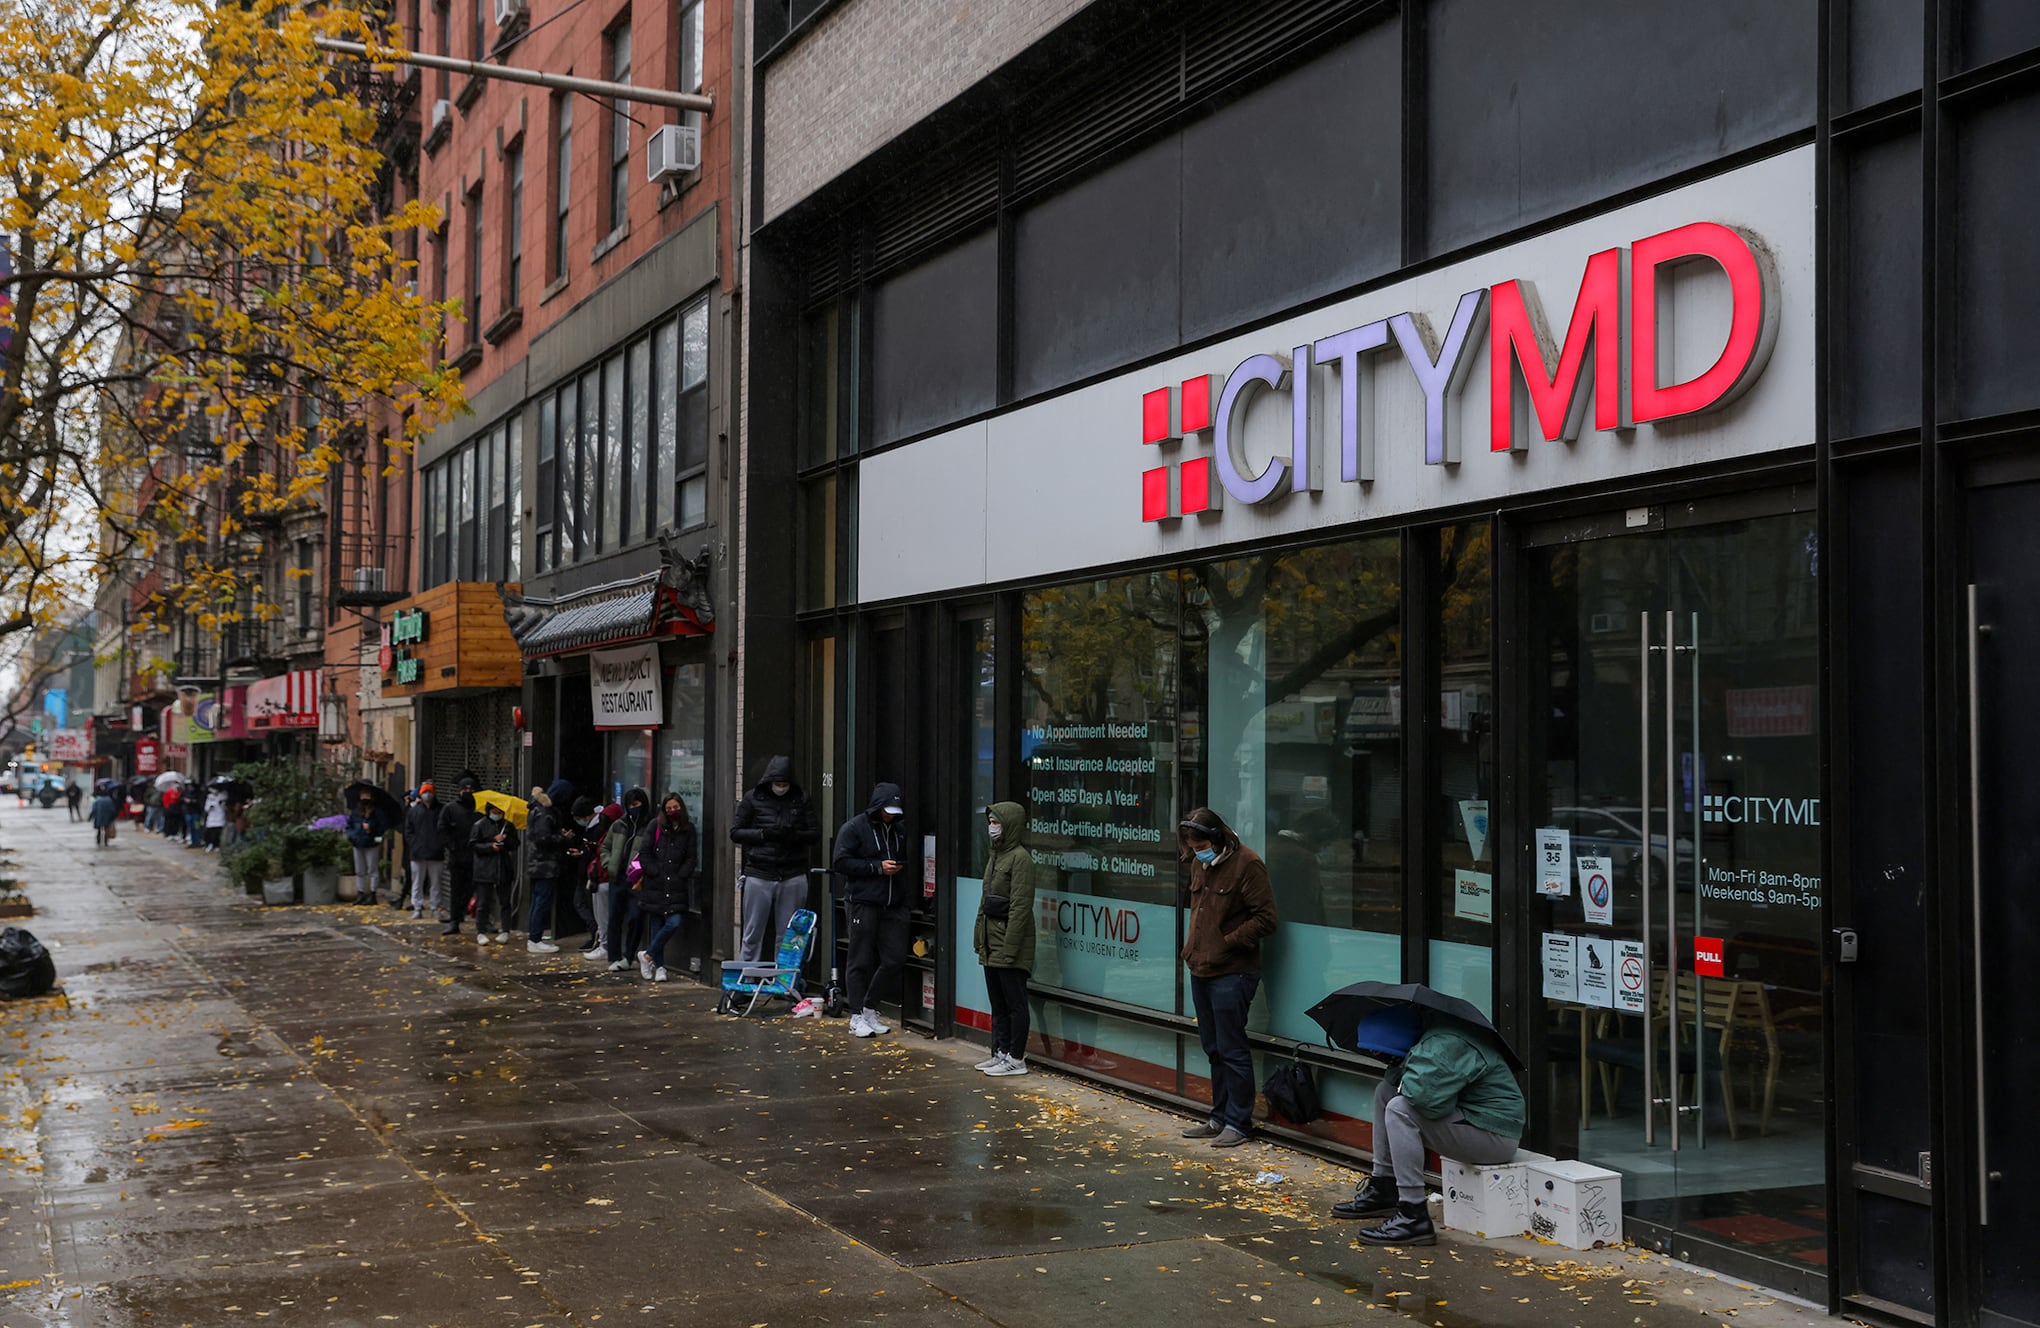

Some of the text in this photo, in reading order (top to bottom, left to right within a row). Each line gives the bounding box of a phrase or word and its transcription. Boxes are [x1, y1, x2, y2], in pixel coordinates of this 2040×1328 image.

[1214, 221, 1778, 504] CITYMD
[601, 689, 654, 713] RESTAURANT
[1032, 722, 1148, 742] No Appointment Needed
[1056, 756, 1103, 772] Insurance
[1106, 756, 1156, 776] Accepted
[1031, 787, 1055, 804] Open
[1057, 788, 1077, 803] 365
[1079, 788, 1103, 807] Days
[1105, 790, 1112, 805] A
[1031, 818, 1161, 843] Board Certified Physicians
[1031, 849, 1065, 868] Serving
[1101, 856, 1109, 872] &
[1111, 856, 1155, 876] Children
[1708, 867, 1821, 891] Mon-Fri 8am-8pm
[1701, 884, 1821, 910] Weekends 9am-5p
[1057, 900, 1140, 944] CITYMD
[1086, 942, 1116, 958] URGENT
[1119, 947, 1139, 962] CARE
[1696, 951, 1721, 963] PULL
[1459, 1191, 1474, 1202] Quest
